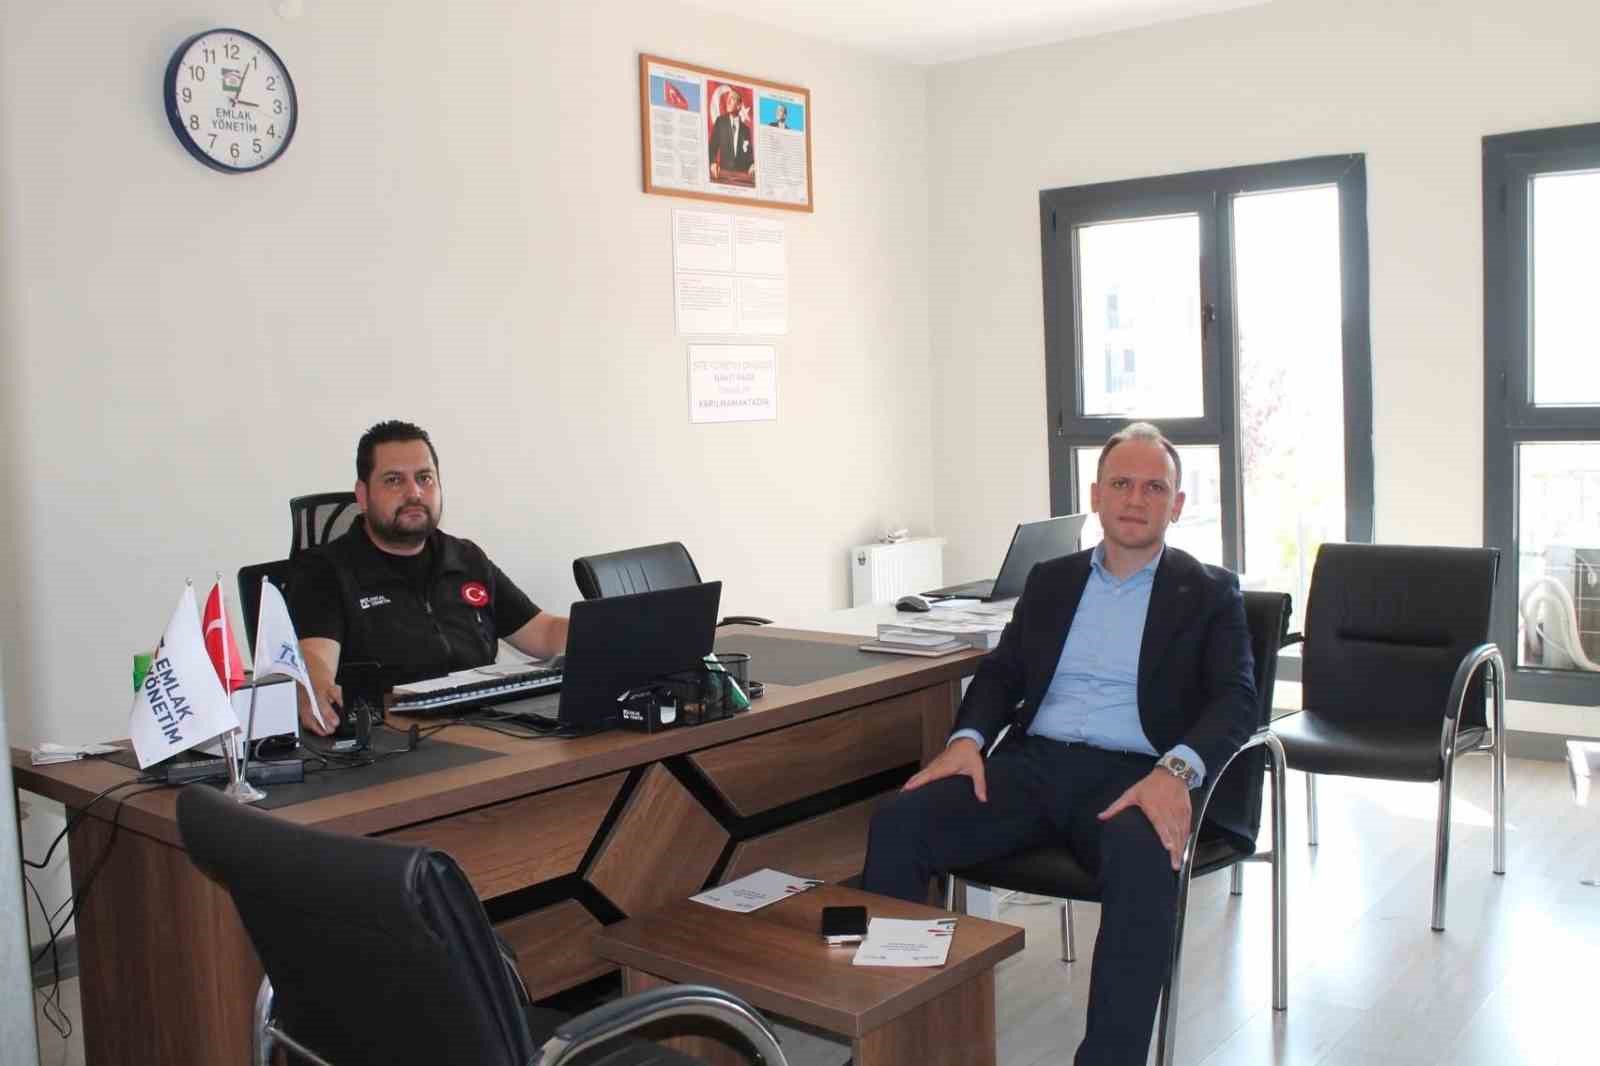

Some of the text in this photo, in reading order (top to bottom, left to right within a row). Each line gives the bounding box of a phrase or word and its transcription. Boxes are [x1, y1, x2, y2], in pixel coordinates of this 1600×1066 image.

[202, 48, 216, 64] 11
[223, 44, 241, 60] 12
[252, 56, 258, 70] 1
[189, 65, 205, 81] 10
[265, 76, 276, 91] 2
[182, 87, 192, 103] 9
[215, 107, 252, 121] EMLAK
[273, 100, 283, 115] 3
[190, 114, 200, 130] 8
[212, 118, 257, 133] YÖNETİM
[266, 123, 275, 138] 4
[208, 132, 218, 148] 7
[252, 138, 262, 154] 5
[230, 142, 240, 159] 6
[155, 657, 194, 721] EMLAK
